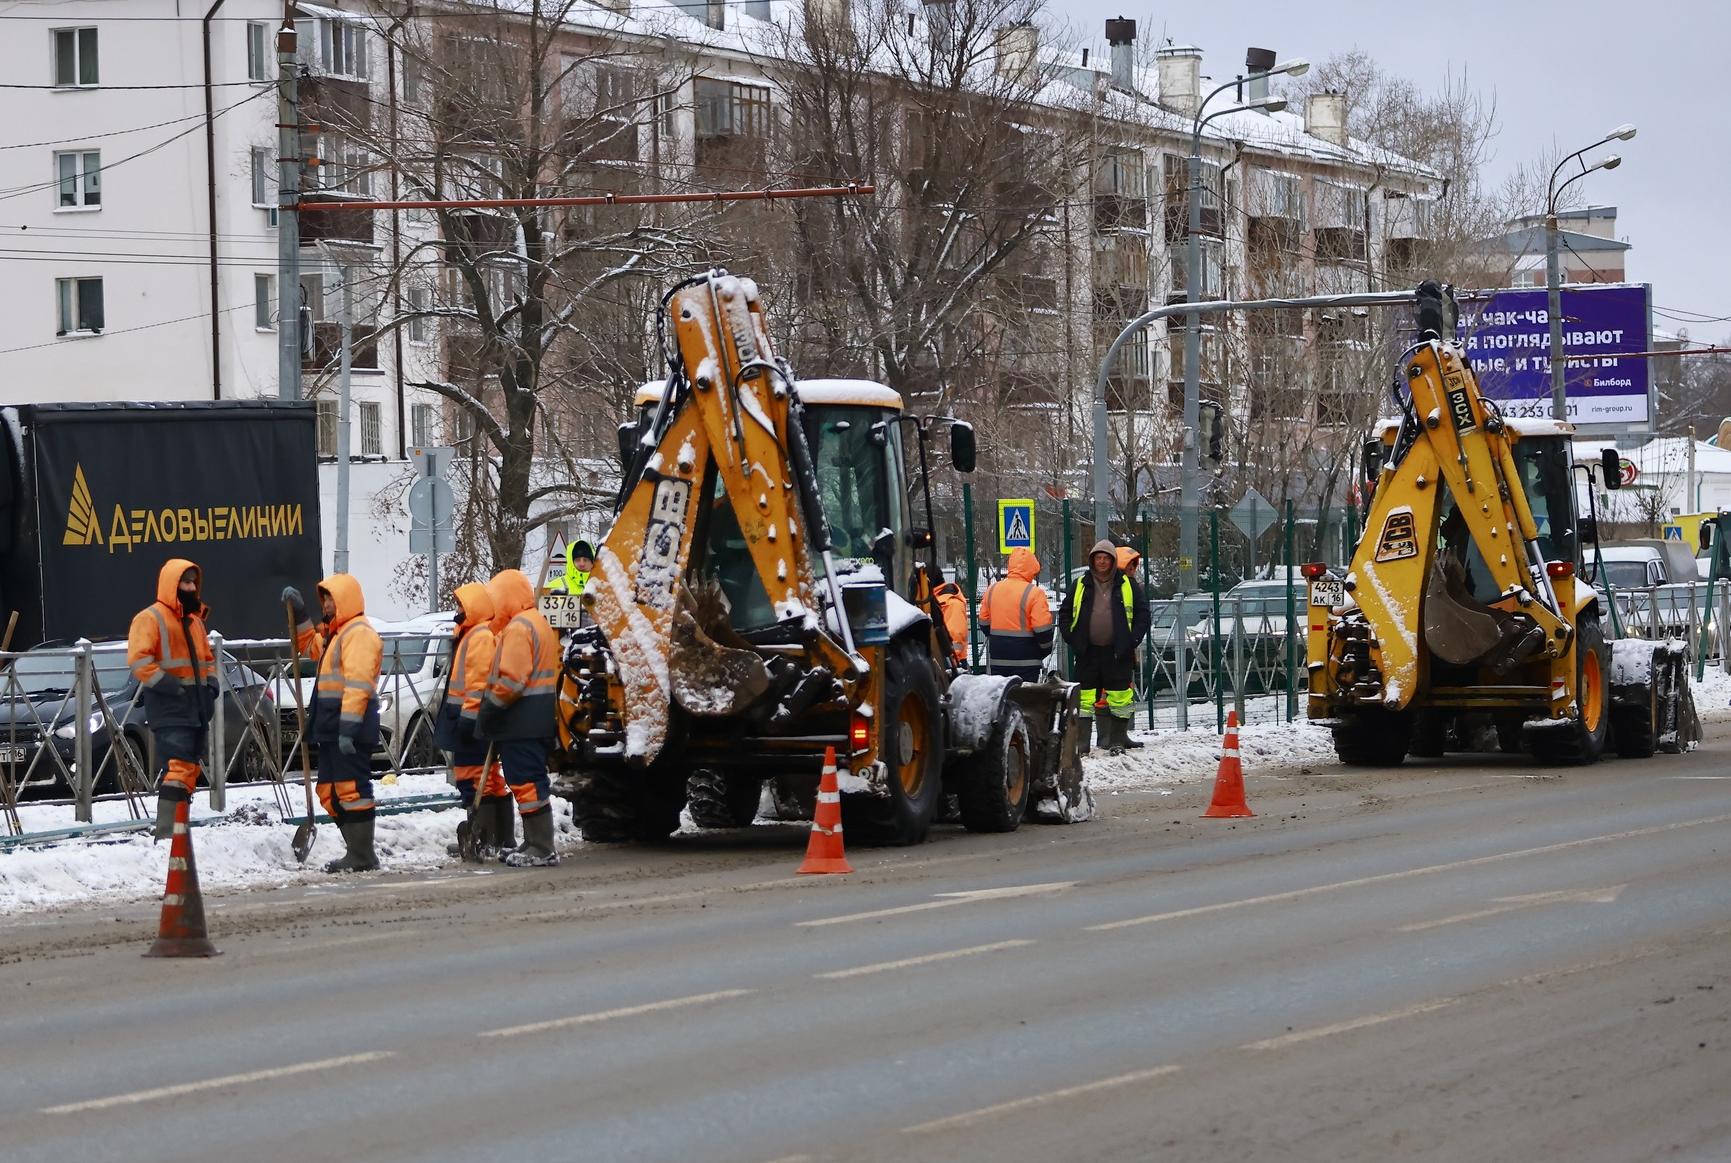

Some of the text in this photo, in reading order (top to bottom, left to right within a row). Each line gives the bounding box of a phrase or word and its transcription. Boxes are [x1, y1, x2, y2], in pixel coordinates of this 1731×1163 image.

[1515, 357, 1528, 371] и
[1593, 378, 1632, 387] Билборд
[1452, 392, 1472, 426] 3CX
[1520, 406, 1544, 418] 233
[1591, 404, 1633, 414] rim-group.ru
[1315, 582, 1340, 593] 4243
[543, 596, 576, 610] 3376
[1331, 594, 1341, 602] 16
[565, 612, 577, 622] 16
